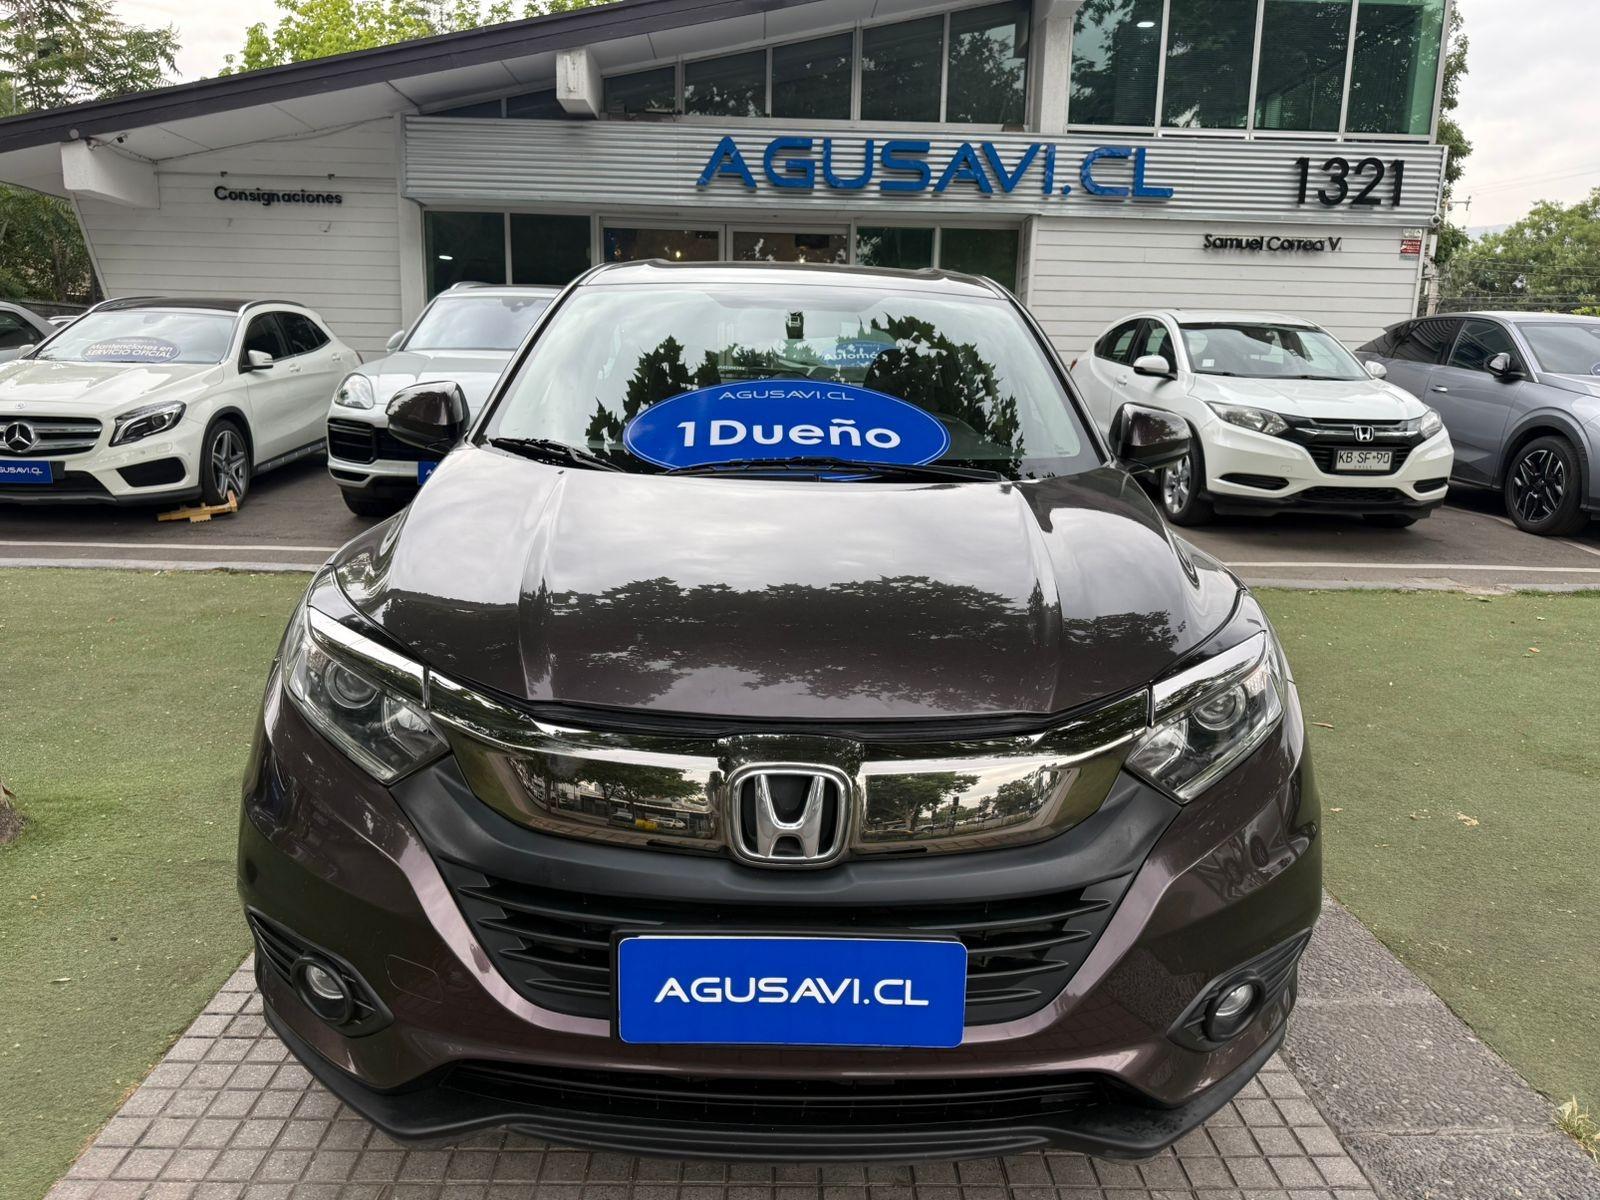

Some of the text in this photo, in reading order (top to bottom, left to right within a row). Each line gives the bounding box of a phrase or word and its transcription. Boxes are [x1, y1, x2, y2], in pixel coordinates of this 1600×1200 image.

[696, 136, 1174, 199] AGUSAVI.CL
[1294, 157, 1405, 207] 1321
[214, 185, 343, 206] Consignaciones
[1203, 234, 1264, 250] Samuel
[1267, 236, 1325, 251] Correa
[89, 343, 158, 351] Mantenciones
[719, 390, 855, 401] AGUSAVI.CL
[677, 418, 901, 449] 1 Dueño
[654, 977, 929, 1006] AGUSAVI.CL
